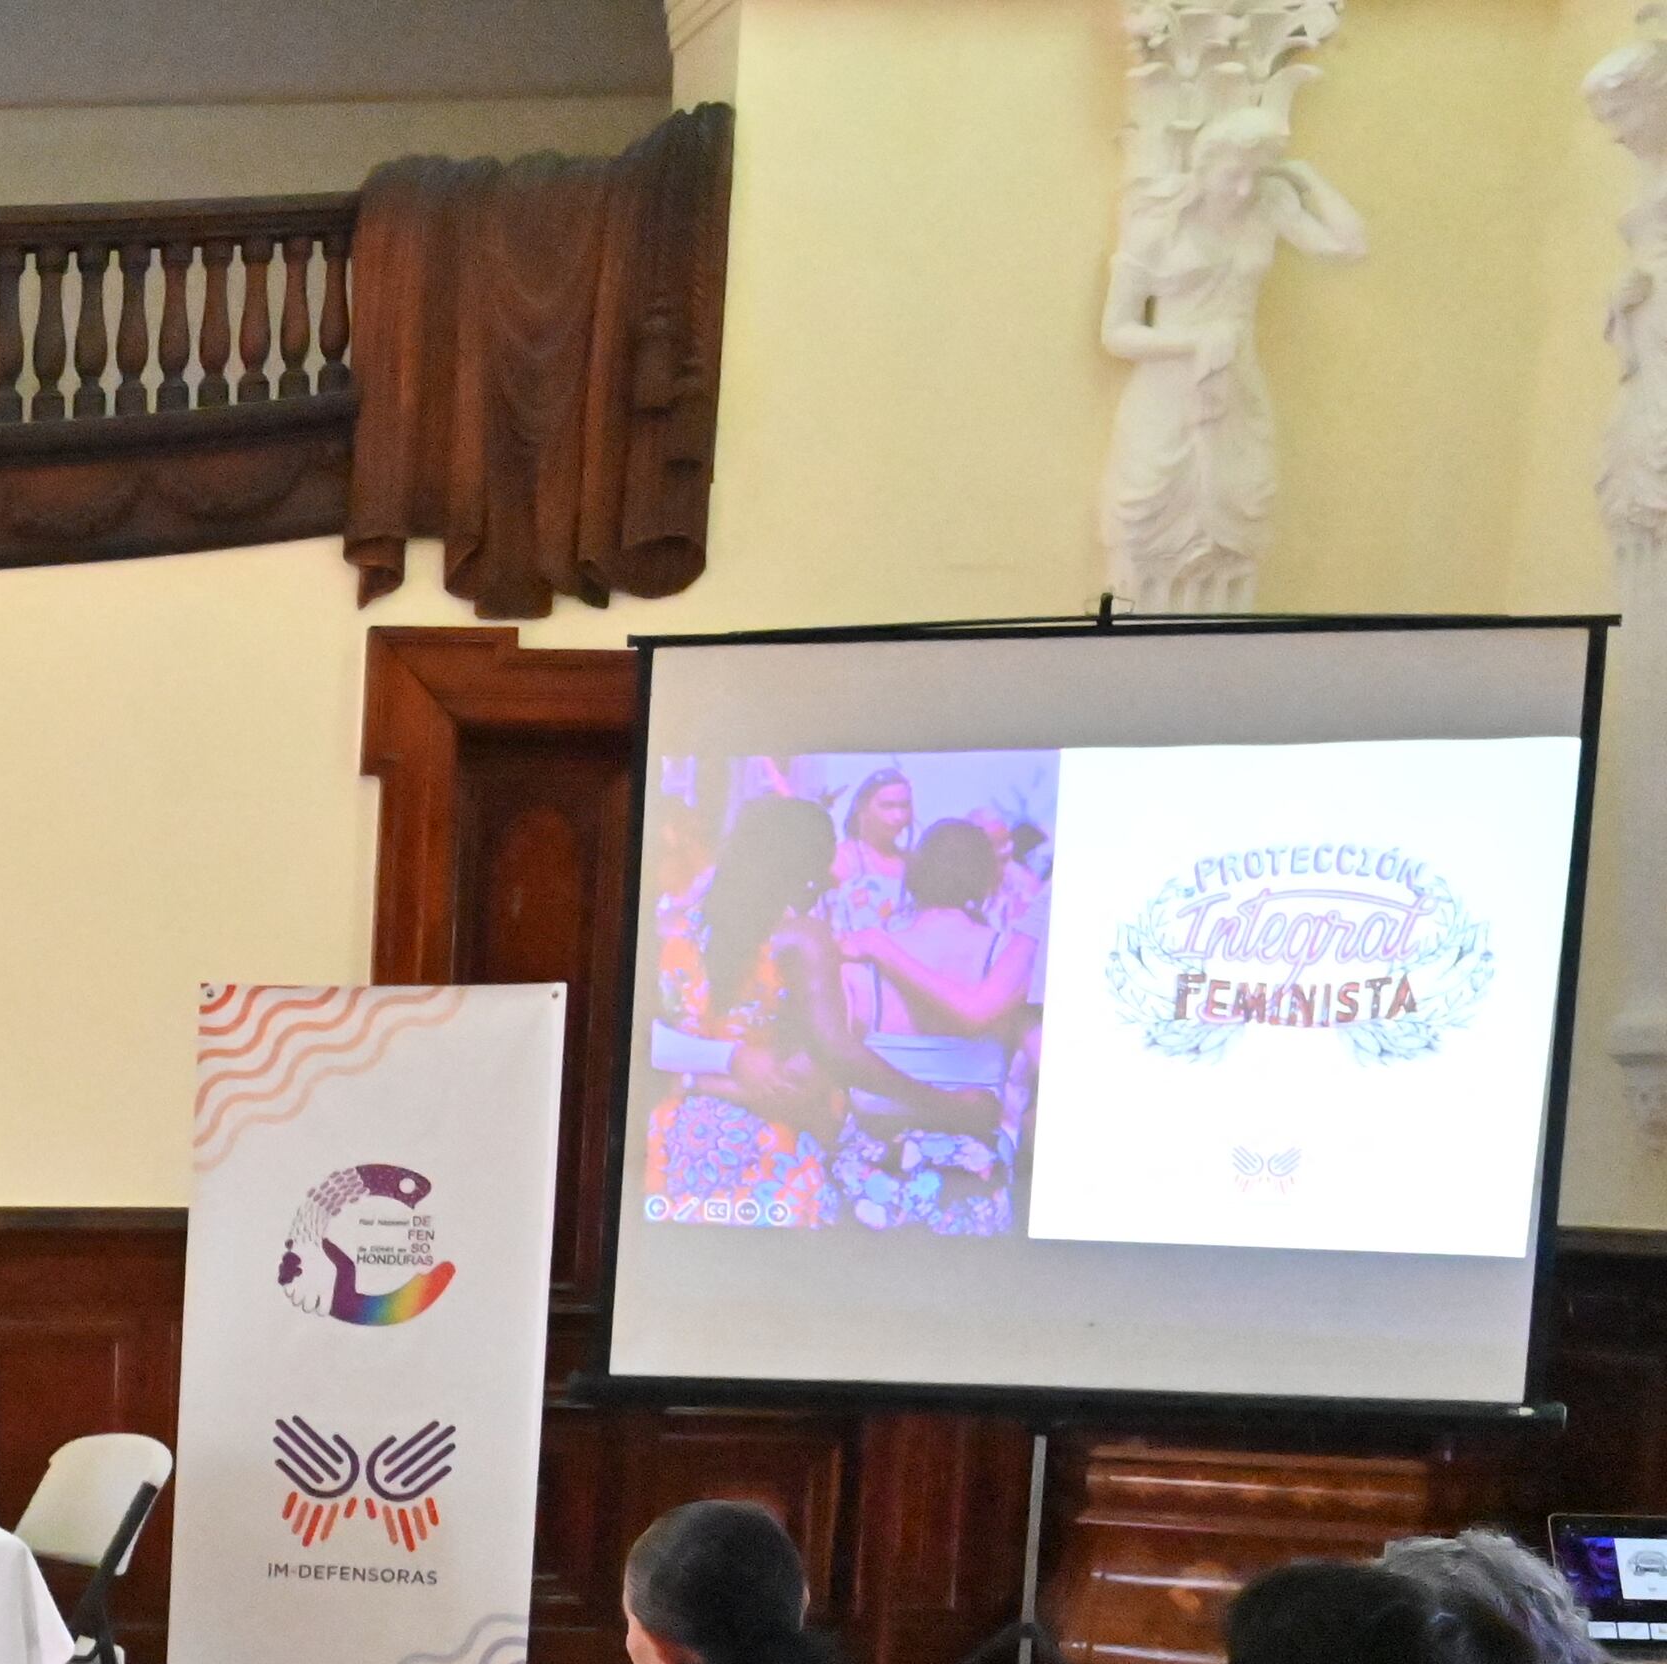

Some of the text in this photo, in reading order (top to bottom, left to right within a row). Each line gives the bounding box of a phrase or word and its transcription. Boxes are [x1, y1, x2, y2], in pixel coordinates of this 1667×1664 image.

[1193, 844, 1427, 892] PROTECCIÓN
[1173, 972, 1419, 1027] FEMINISTA
[412, 1215, 431, 1227] DE
[408, 1230, 435, 1241] FEN
[356, 1254, 434, 1266] HONDURAS
[267, 1563, 438, 1585] IM-DEFENSORAS
